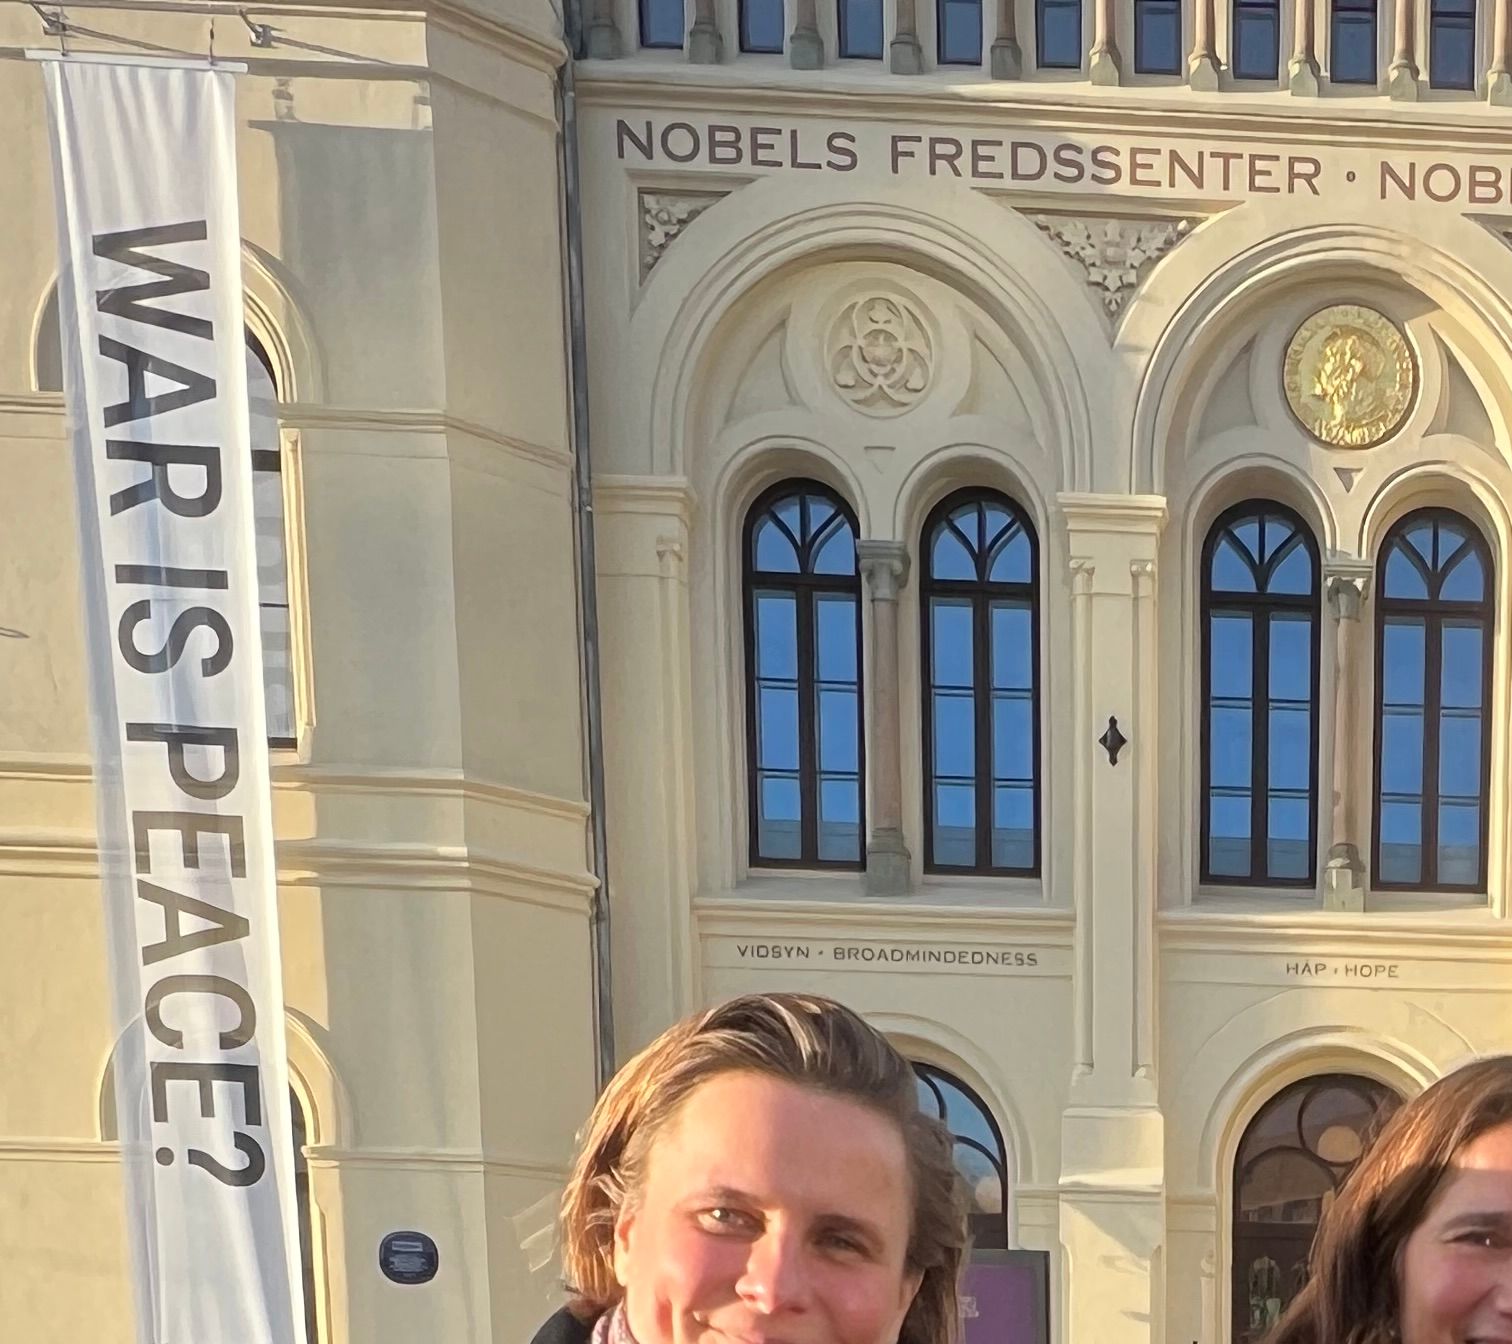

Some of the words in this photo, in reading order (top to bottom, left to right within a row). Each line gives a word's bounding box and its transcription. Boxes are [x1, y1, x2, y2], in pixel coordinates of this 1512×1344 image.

[615, 118, 858, 171] NOBELS
[890, 135, 1322, 196] FREDSSENTER
[91, 219, 224, 518] WAR
[114, 563, 234, 679] IS
[125, 722, 266, 1188] PEACE?
[737, 944, 810, 960] VIDSYN
[833, 947, 1039, 967] BROADMINDEDNESS
[1285, 958, 1328, 977] HÅP
[1344, 963, 1400, 979] HOPE
